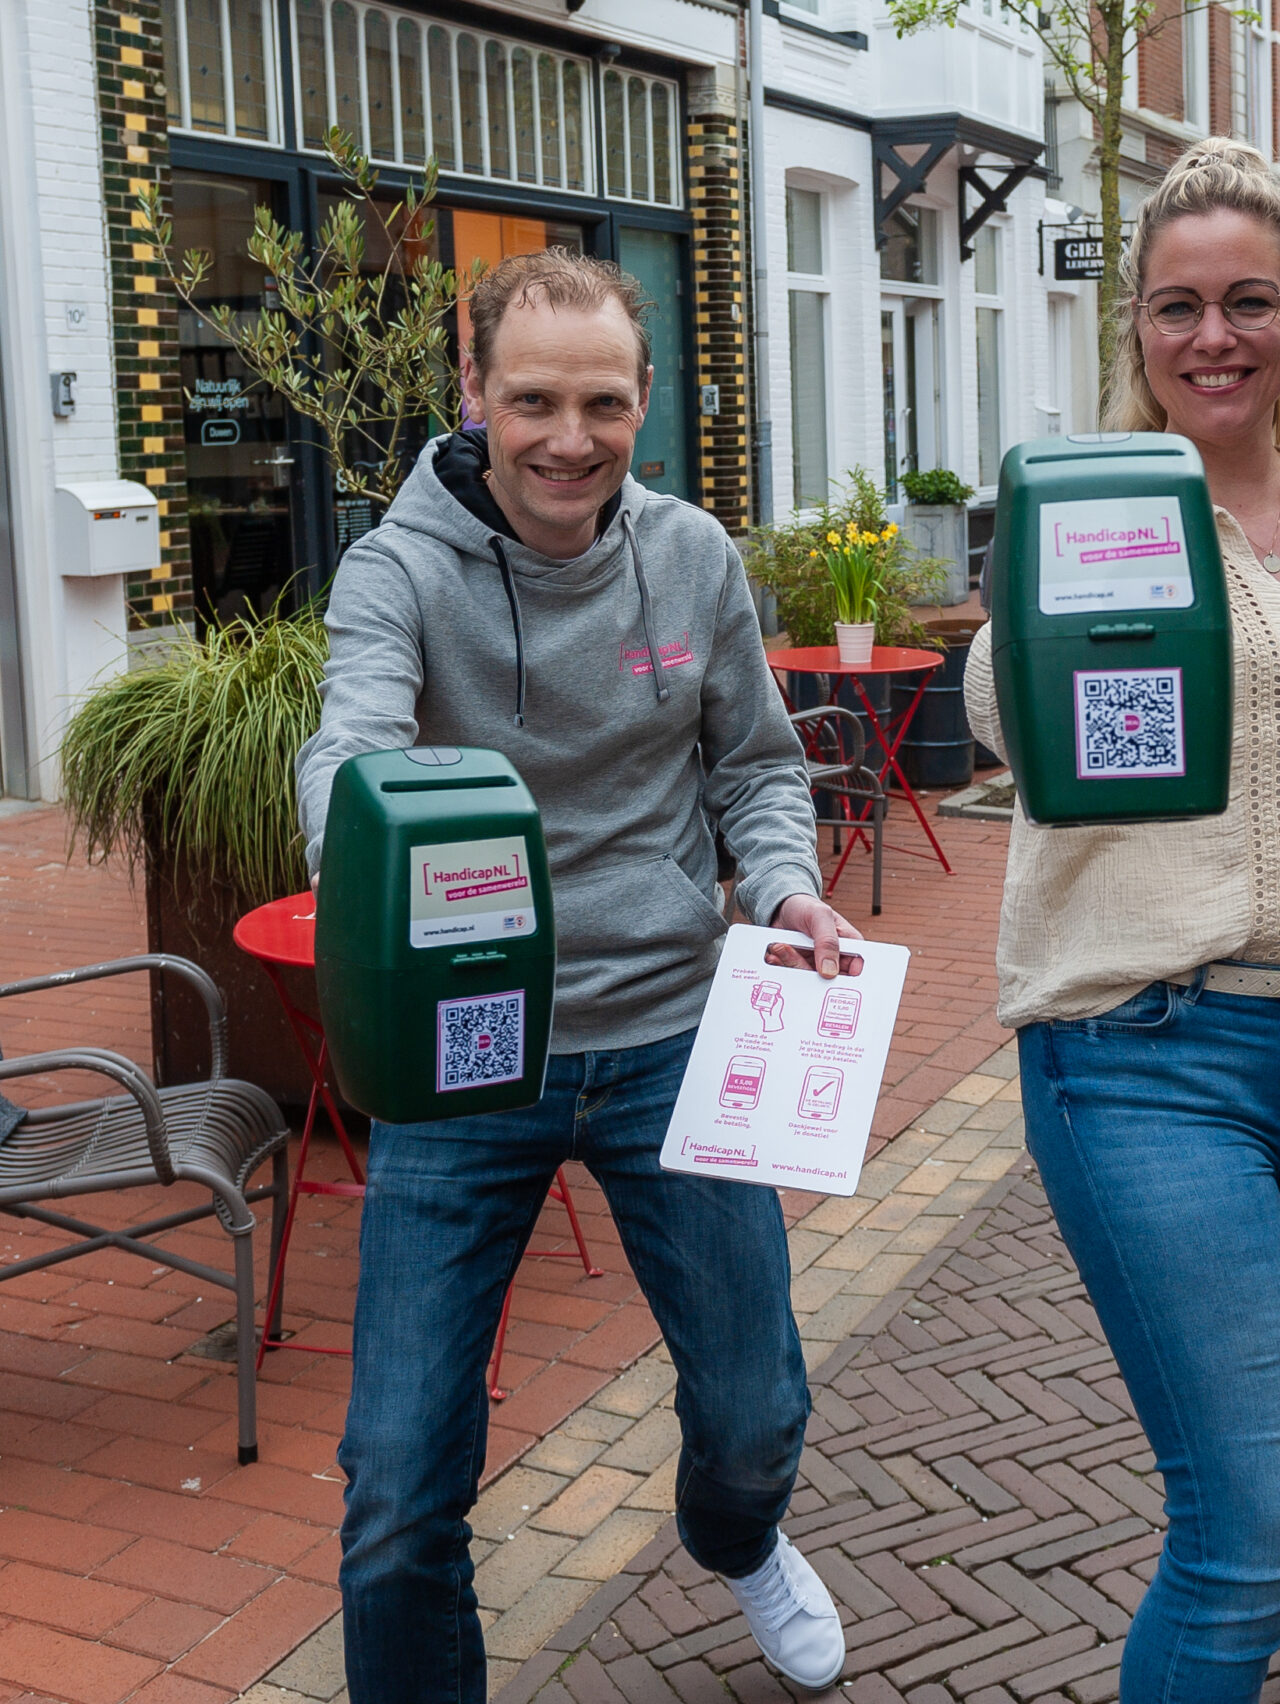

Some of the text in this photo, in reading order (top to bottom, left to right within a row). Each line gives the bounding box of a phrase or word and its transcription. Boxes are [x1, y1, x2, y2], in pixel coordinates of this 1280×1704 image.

[196, 378, 241, 396] Natuurlijk
[223, 397, 249, 412] open
[1066, 528, 1158, 544] HandicapNL
[1105, 550, 1116, 558] de
[1118, 544, 1178, 557] samenwereld
[434, 865, 510, 883] HandicapNL
[448, 879, 526, 899] voor de samenwereld
[424, 924, 475, 936] www.handicap.nl
[689, 1142, 746, 1156] HandicapNL
[772, 1163, 847, 1178] www.handicap.nl
